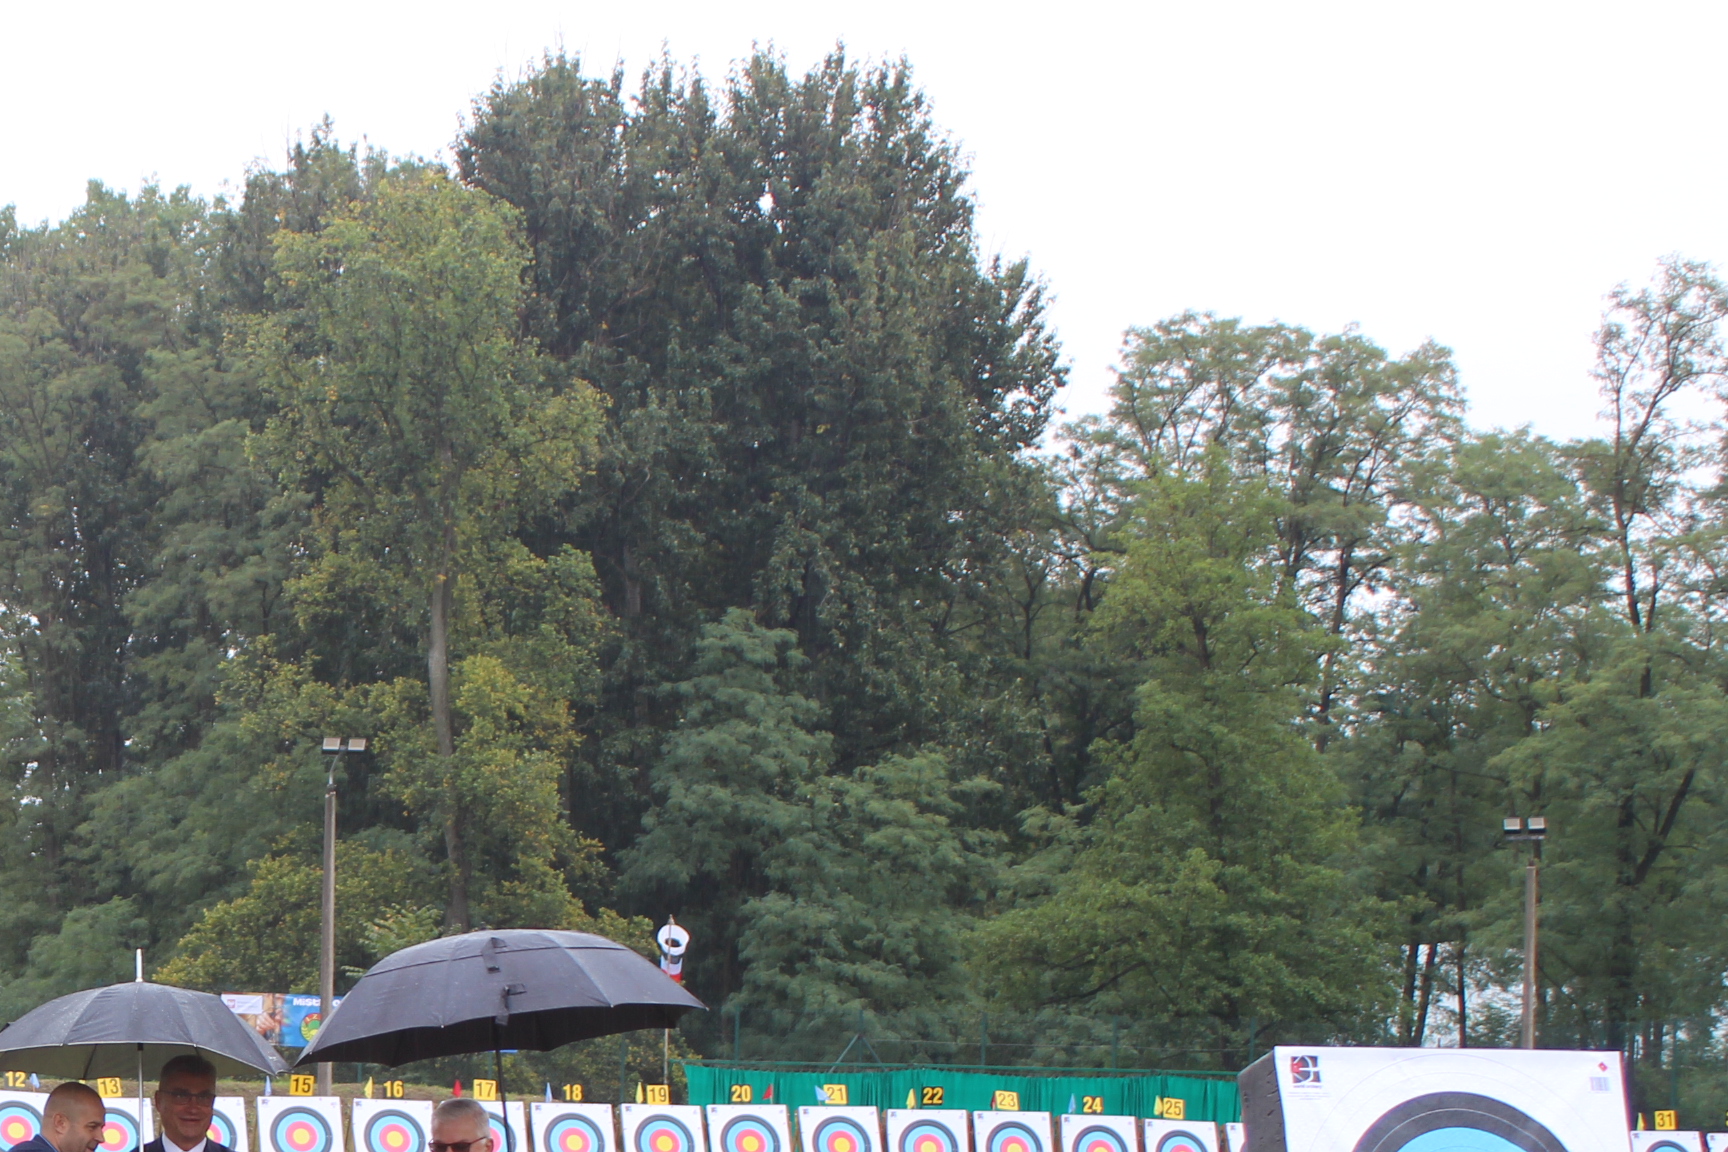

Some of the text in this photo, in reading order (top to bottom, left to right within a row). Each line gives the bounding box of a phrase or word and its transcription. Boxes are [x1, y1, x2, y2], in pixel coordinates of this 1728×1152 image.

[5, 1071, 26, 1087] 12
[100, 1079, 119, 1095] 13
[293, 1077, 312, 1093] 15
[383, 1080, 403, 1098] 16
[475, 1082, 494, 1097] 17
[563, 1084, 582, 1101] 18
[649, 1087, 667, 1103] 19
[731, 1085, 751, 1102] 20
[827, 1086, 844, 1101] 21
[923, 1087, 943, 1104] 22
[998, 1093, 1016, 1108] 23
[1083, 1096, 1103, 1113] 24
[1165, 1100, 1182, 1115] 25
[1657, 1112, 1673, 1127] 31
